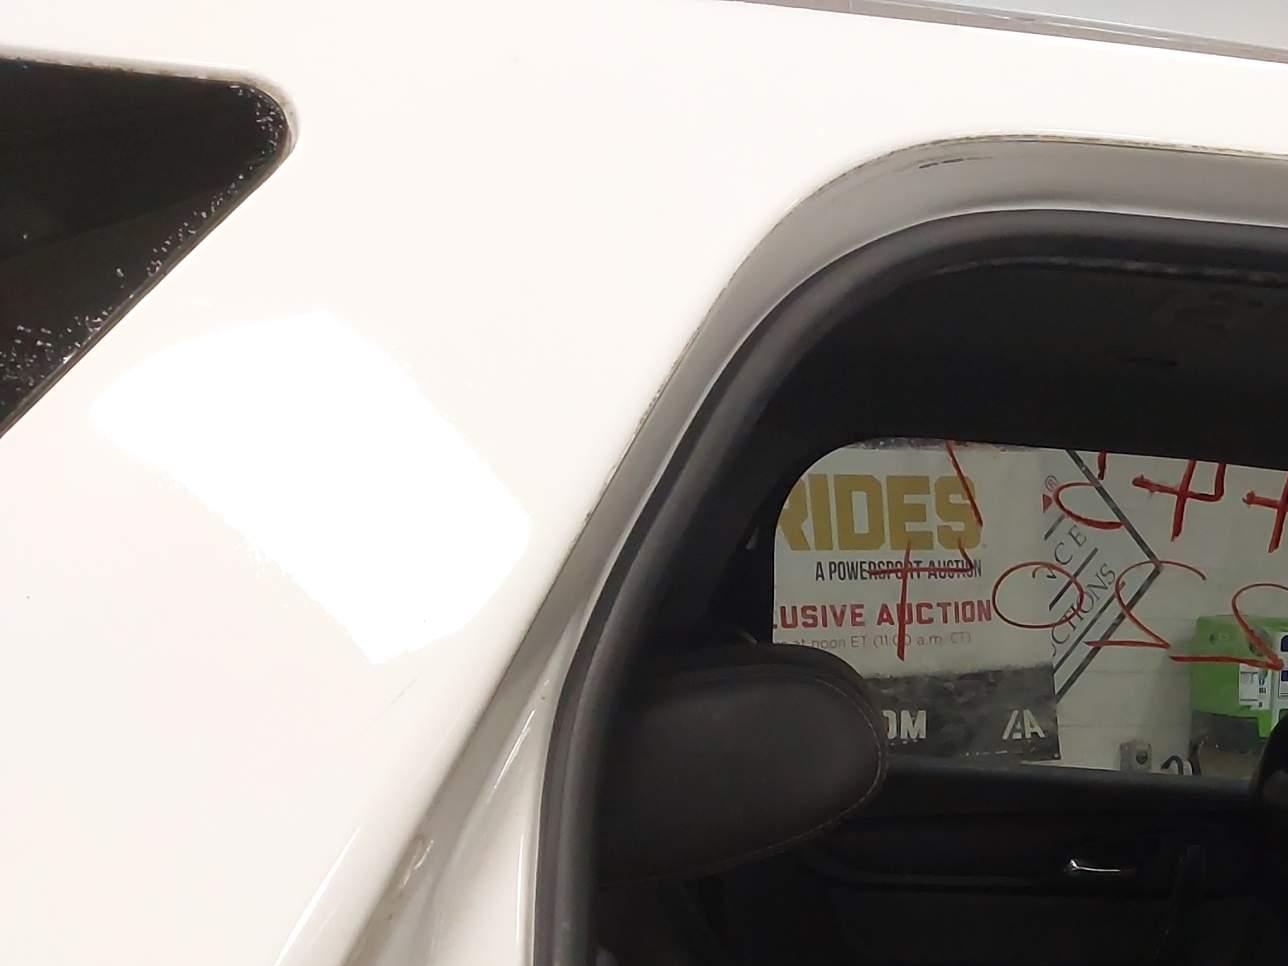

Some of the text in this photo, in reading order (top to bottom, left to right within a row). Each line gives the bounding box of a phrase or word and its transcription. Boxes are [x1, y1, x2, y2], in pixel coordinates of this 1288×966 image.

[815, 560, 983, 582] A POWERSPORT AUCTION
[773, 599, 993, 629] USIVE AUCTION
